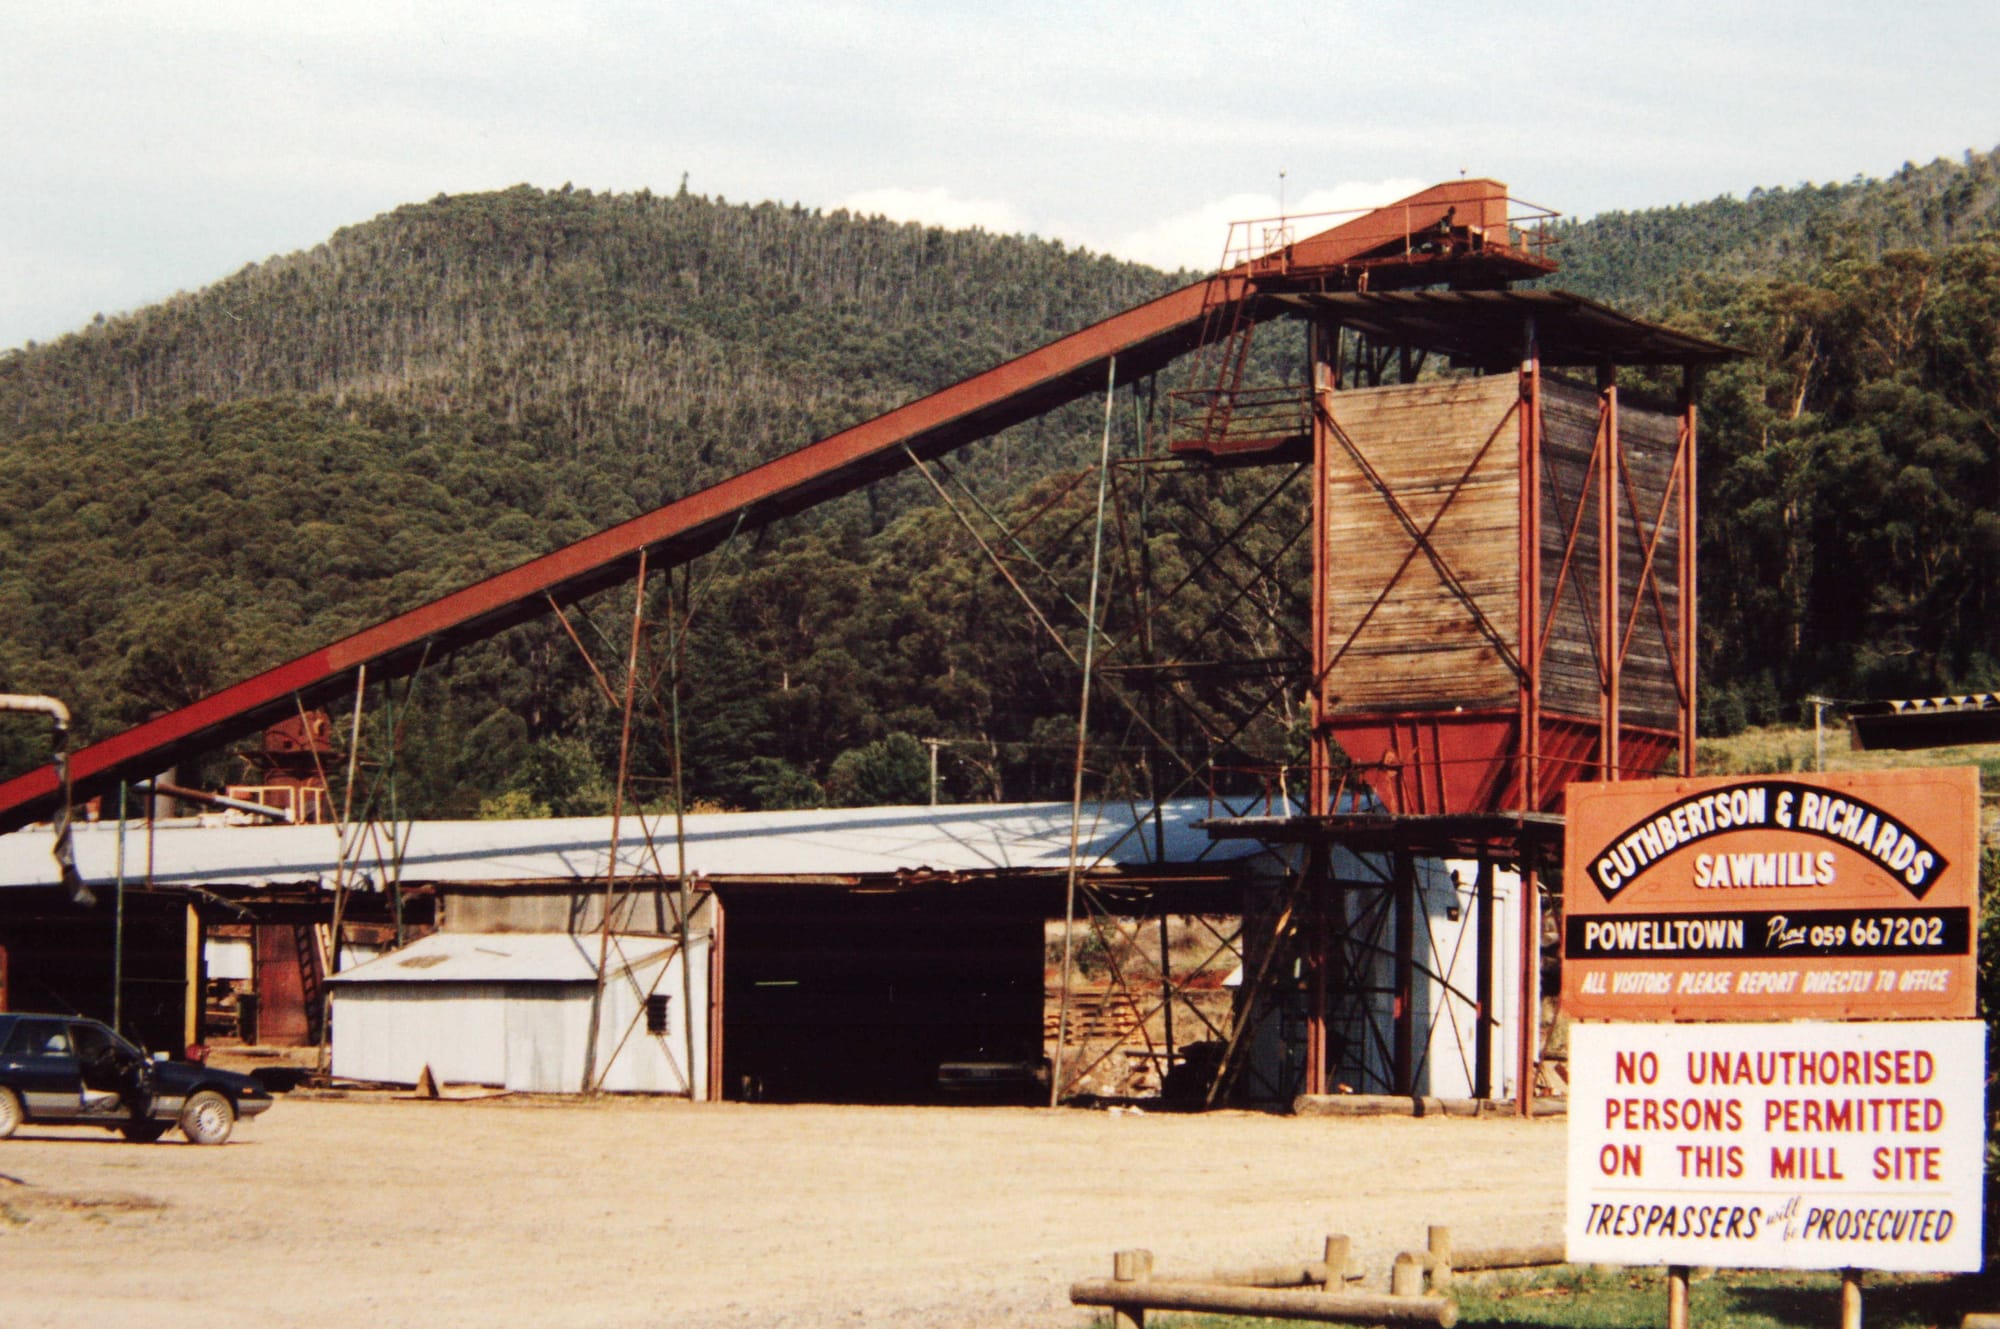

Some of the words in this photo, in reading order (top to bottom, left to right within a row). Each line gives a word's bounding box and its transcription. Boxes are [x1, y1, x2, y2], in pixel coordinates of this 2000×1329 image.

[1597, 788, 1765, 890] CUTHBERTSON
[1775, 791, 1793, 828] &
[1800, 792, 1933, 885] RICHARDS
[1694, 852, 1835, 888] SAWMILLS
[1584, 920, 1744, 950] POWELLTOWN
[1810, 925, 1845, 946] 059
[1851, 918, 1943, 946] 667202
[1581, 972, 1606, 993] ALL
[1613, 971, 1672, 993] VISITORS
[1677, 970, 1732, 993] PLEASE
[1737, 970, 1798, 993] REPORT
[1803, 970, 1873, 993] DIRECTLY
[1876, 970, 1893, 992] TO
[1898, 969, 1949, 992] OFFICE
[1616, 1051, 1657, 1085] NO
[1687, 1050, 1933, 1085] UNAUTHORISED
[1605, 1099, 1743, 1130] PERSONS
[1765, 1099, 1943, 1132] PERMITTED
[1600, 1144, 1642, 1176] ON
[1677, 1146, 1743, 1177] THIS
[1770, 1147, 1843, 1179] MILL
[1872, 1146, 1941, 1179] SITE
[1586, 1203, 1761, 1239] TRESPASSERS
[1766, 1195, 1802, 1225] will
[1803, 1208, 1953, 1241] PROSECUTED
[1782, 1223, 1800, 1241] be
